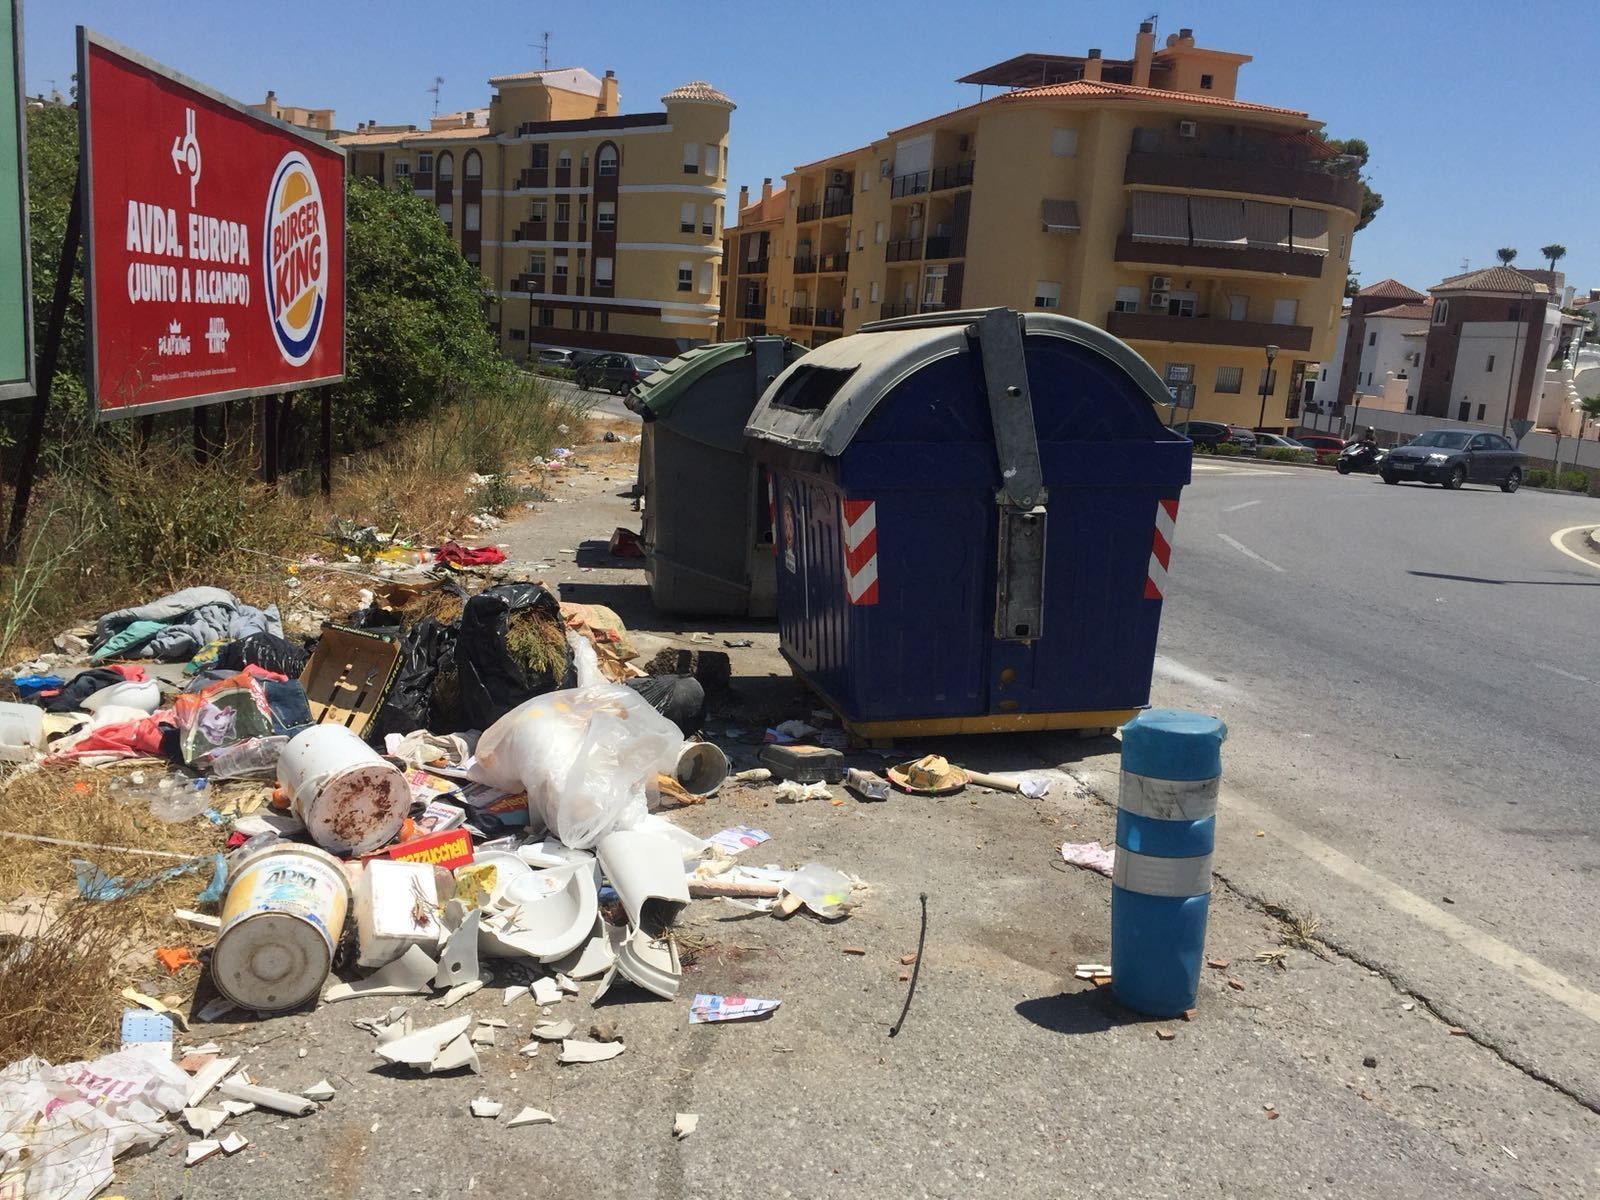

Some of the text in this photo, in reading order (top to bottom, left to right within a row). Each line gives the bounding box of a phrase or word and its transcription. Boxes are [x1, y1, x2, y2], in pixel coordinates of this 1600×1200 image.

[126, 199, 250, 266] AVDA. EUROPA
[273, 200, 320, 267] BURGER
[127, 262, 250, 308] (JUNTO A ALCAMPO)
[275, 233, 321, 319] KING
